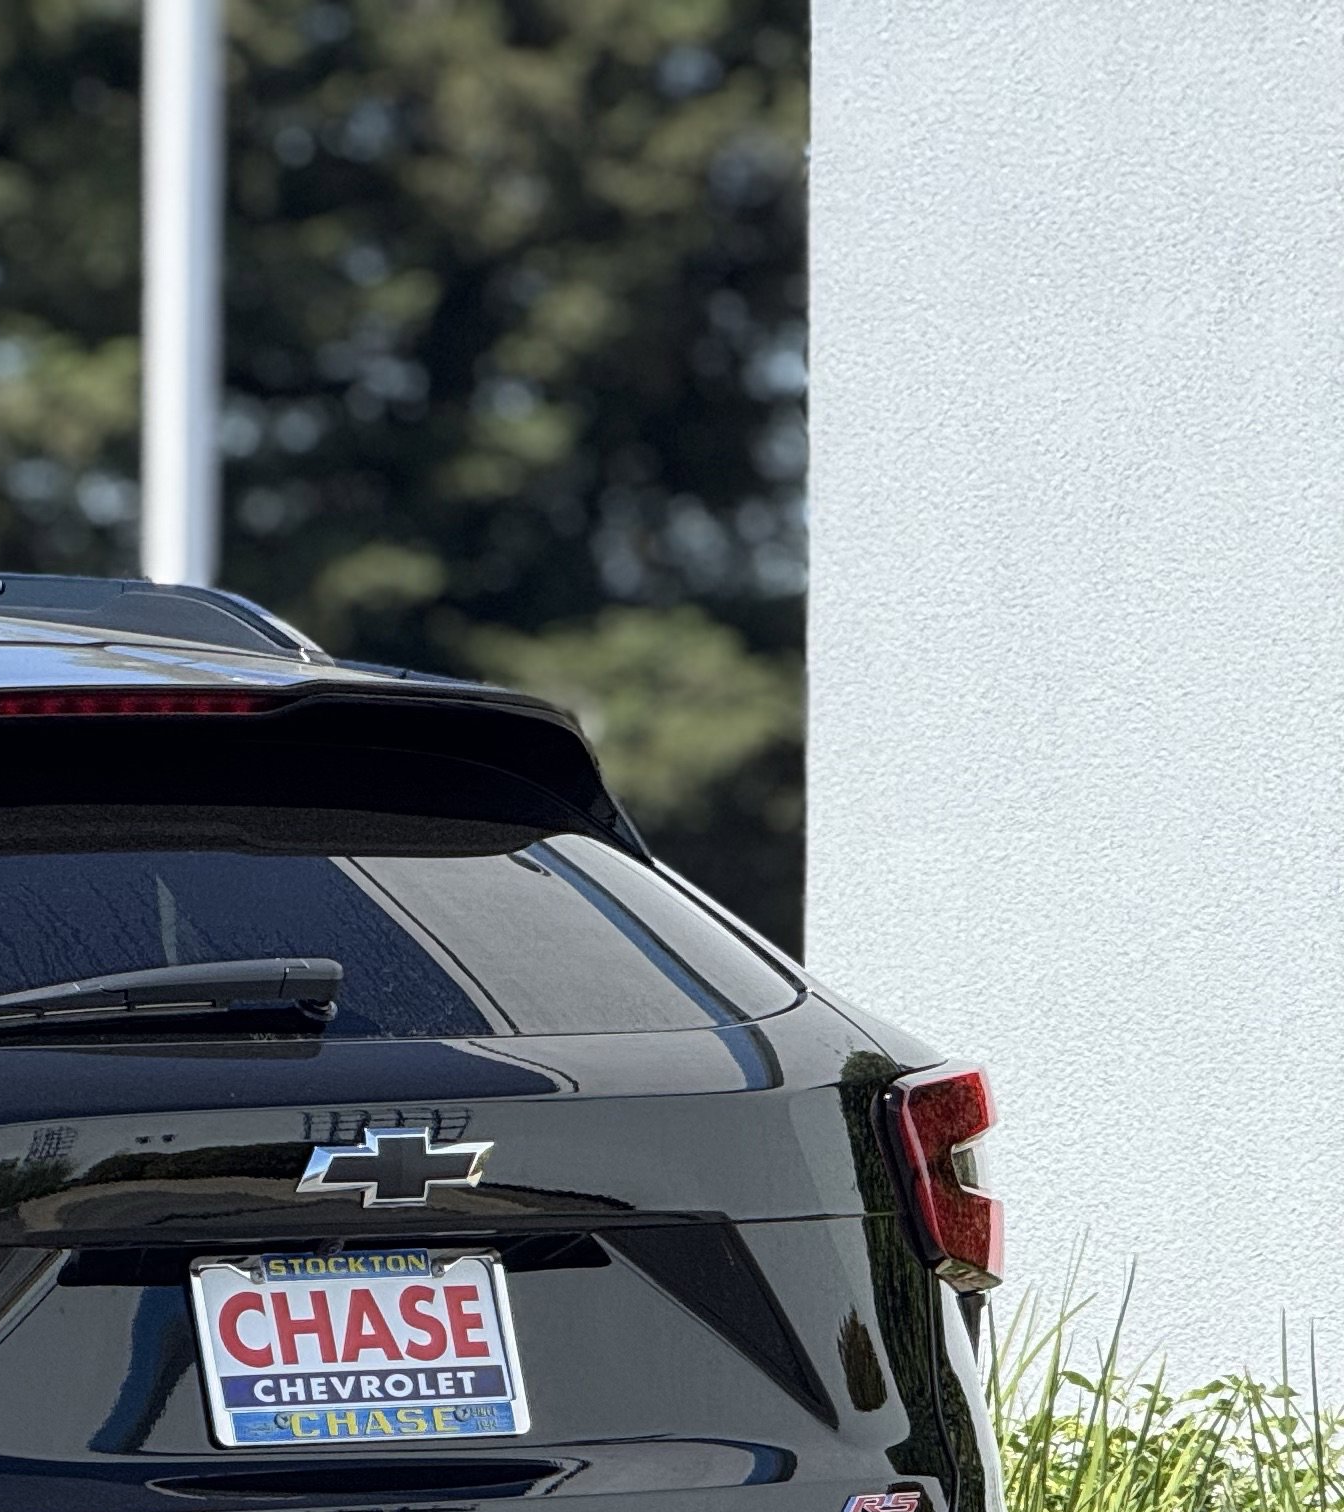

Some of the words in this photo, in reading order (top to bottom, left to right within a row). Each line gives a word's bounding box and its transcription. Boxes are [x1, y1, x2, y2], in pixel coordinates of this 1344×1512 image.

[268, 1254, 427, 1276] STOCKTON
[218, 1285, 490, 1368] CHASE
[253, 1371, 476, 1402] CHEVROLET
[290, 1406, 462, 1438] CHASE
